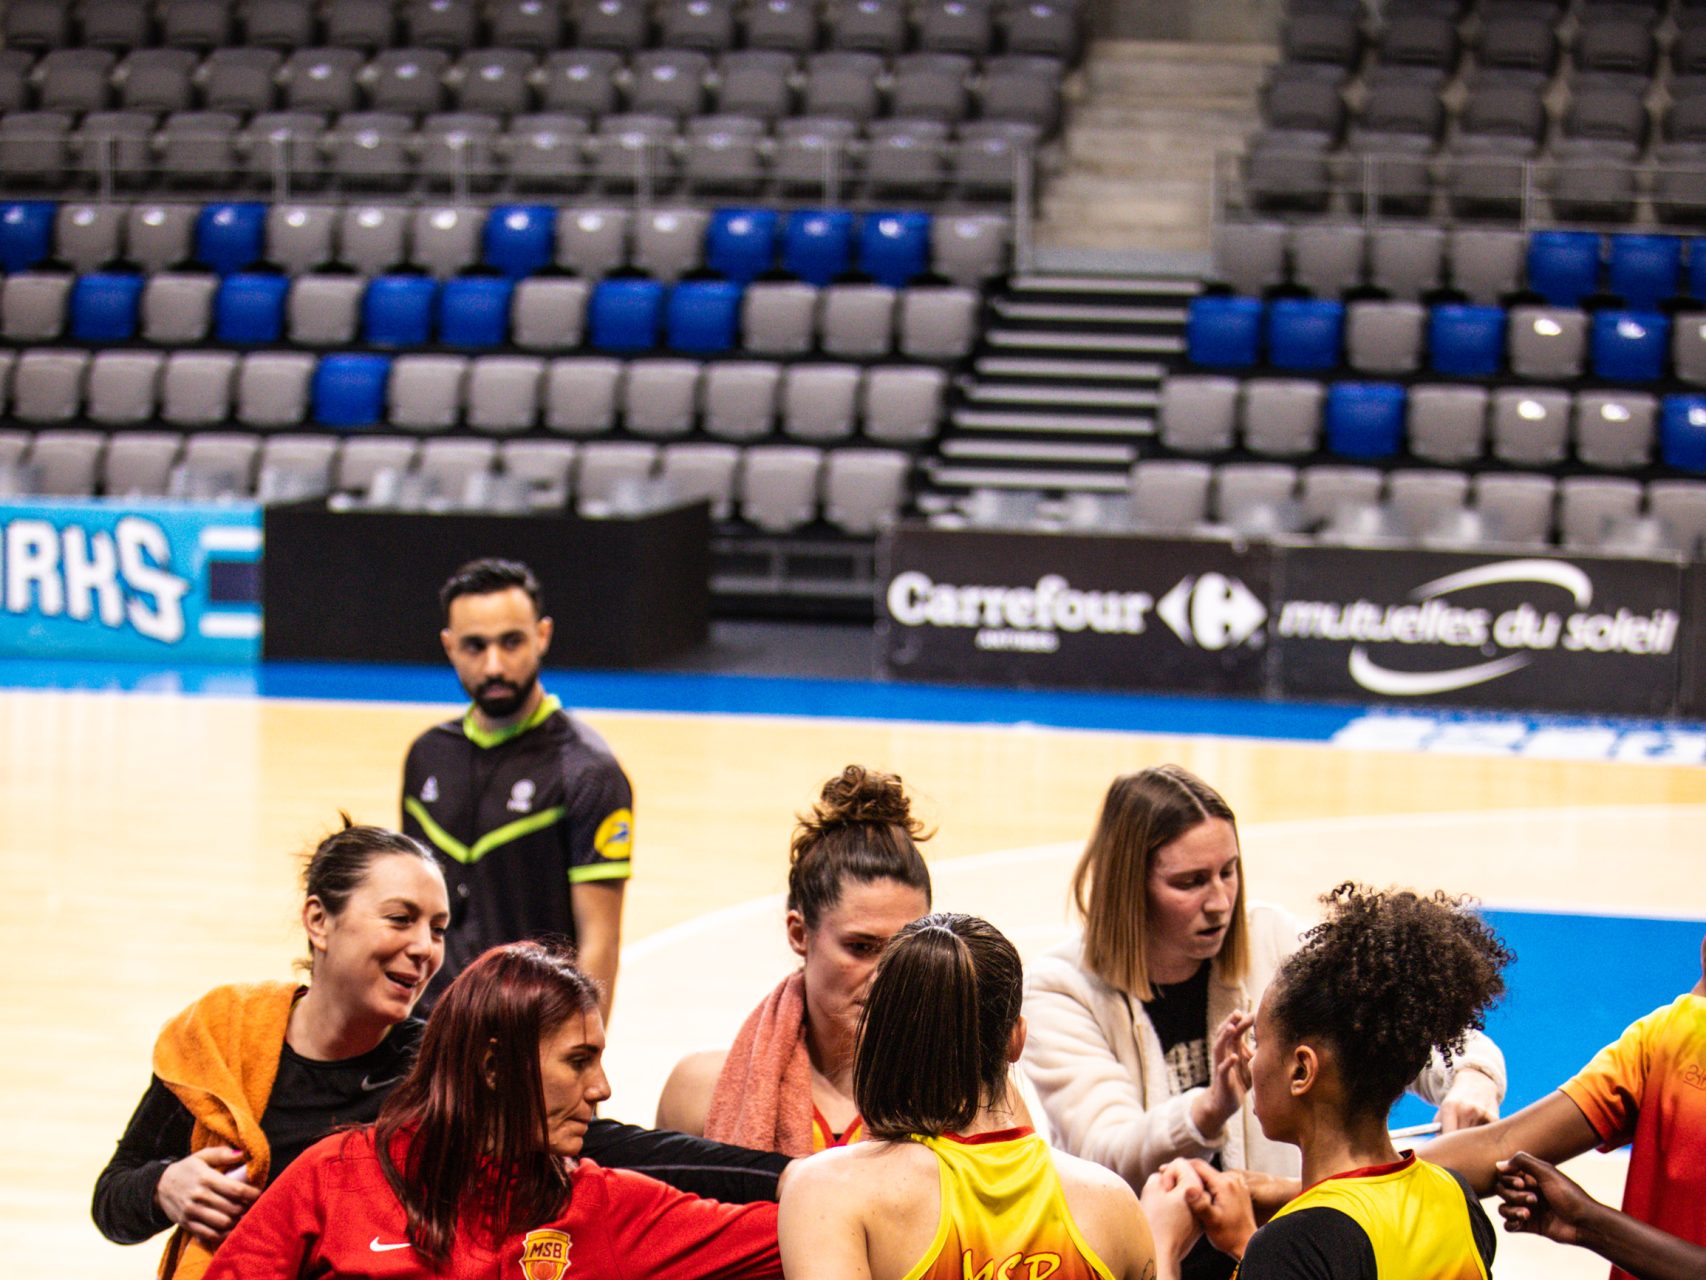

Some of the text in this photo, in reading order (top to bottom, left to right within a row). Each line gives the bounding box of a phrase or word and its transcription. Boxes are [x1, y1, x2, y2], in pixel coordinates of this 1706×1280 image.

[888, 571, 1150, 634] Carrefour
[1278, 598, 1681, 656] mutuelles du soleil
[529, 1241, 563, 1259] MSB
